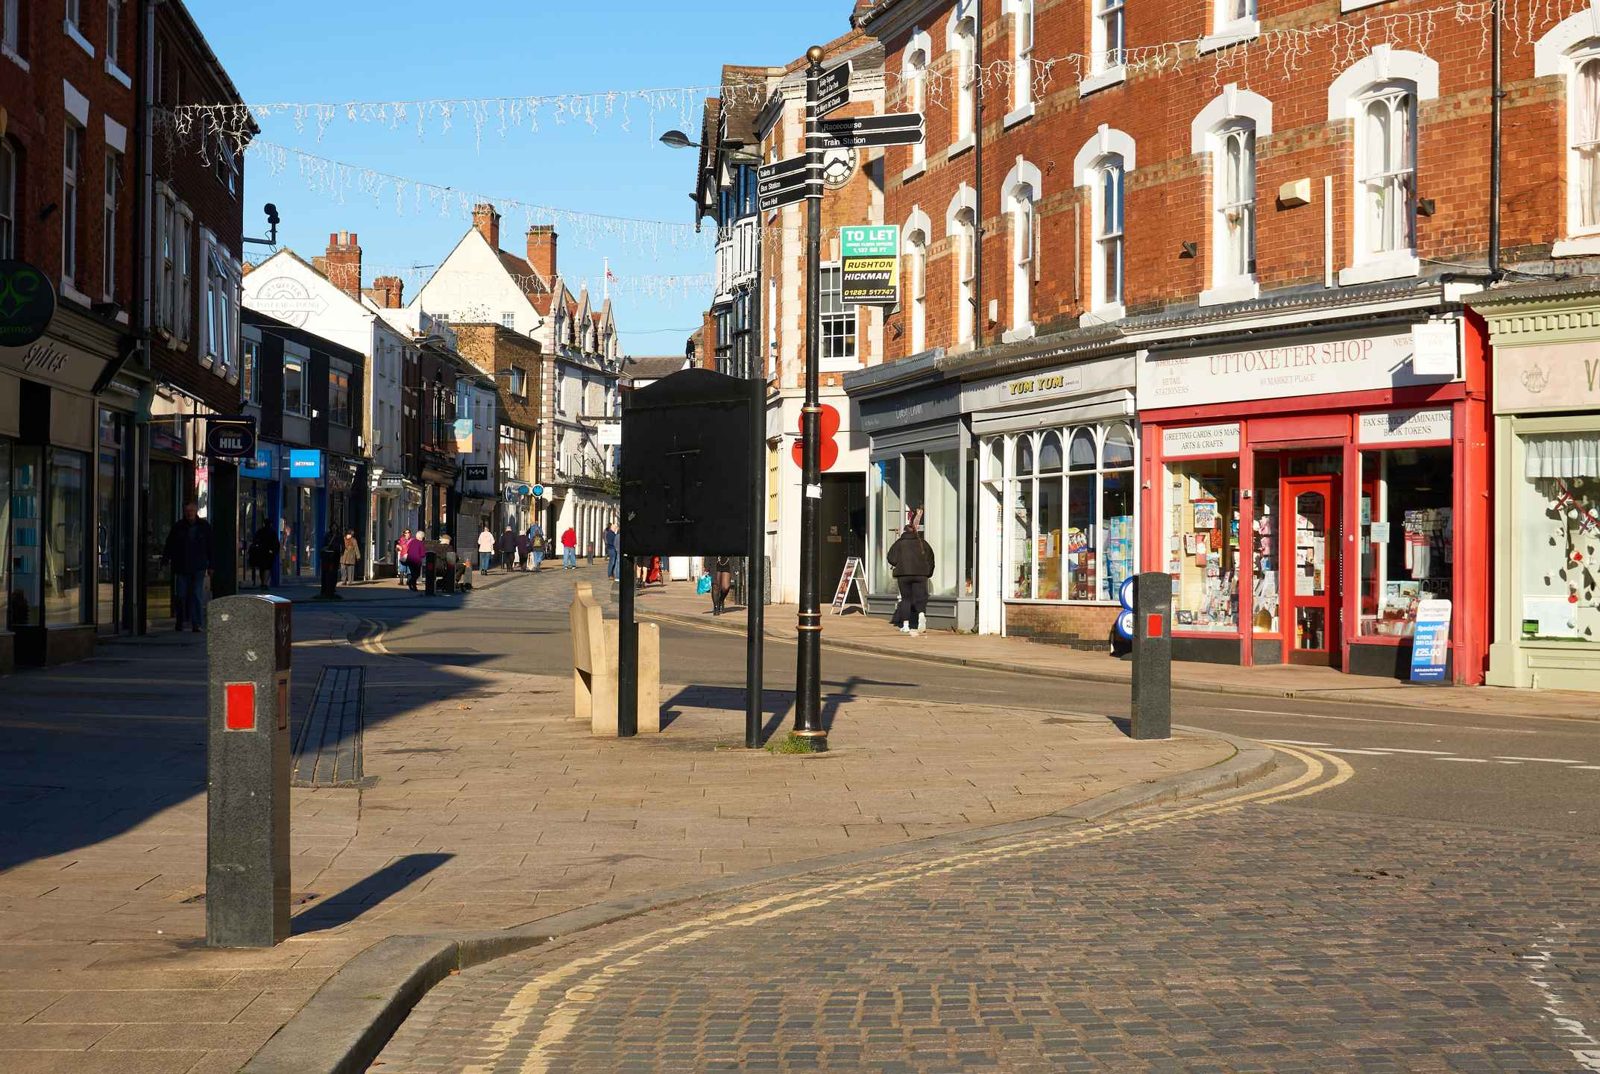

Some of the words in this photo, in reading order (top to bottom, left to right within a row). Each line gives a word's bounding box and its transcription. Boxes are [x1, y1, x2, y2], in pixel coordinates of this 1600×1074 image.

[823, 122, 862, 131] Racecourse
[823, 138, 840, 146] Train
[843, 137, 866, 145] Station
[768, 182, 781, 191] Station
[762, 200, 771, 208] Town
[846, 230, 865, 242] TO
[869, 229, 895, 241] LET
[847, 261, 894, 269] RUSHTON
[844, 272, 890, 281] HICKMAN
[1208, 345, 1318, 377] UTTOXETER
[1321, 337, 1374, 366] SHOP
[1009, 380, 1034, 396] YUM
[1037, 374, 1064, 392] YUM
[1267, 377, 1293, 386] MARKET
[1294, 374, 1315, 383] PLACE
[1363, 418, 1377, 427] FAX
[1408, 412, 1452, 424] LAMINATING
[1165, 431, 1192, 441] GREETING
[1223, 428, 1240, 437] MAPS
[1383, 427, 1404, 437] BOOK
[1404, 425, 1432, 436] TOKENS
[219, 438, 243, 449] HILL
[1181, 441, 1196, 450] ARTS
[1201, 440, 1224, 449] CRAFTS
